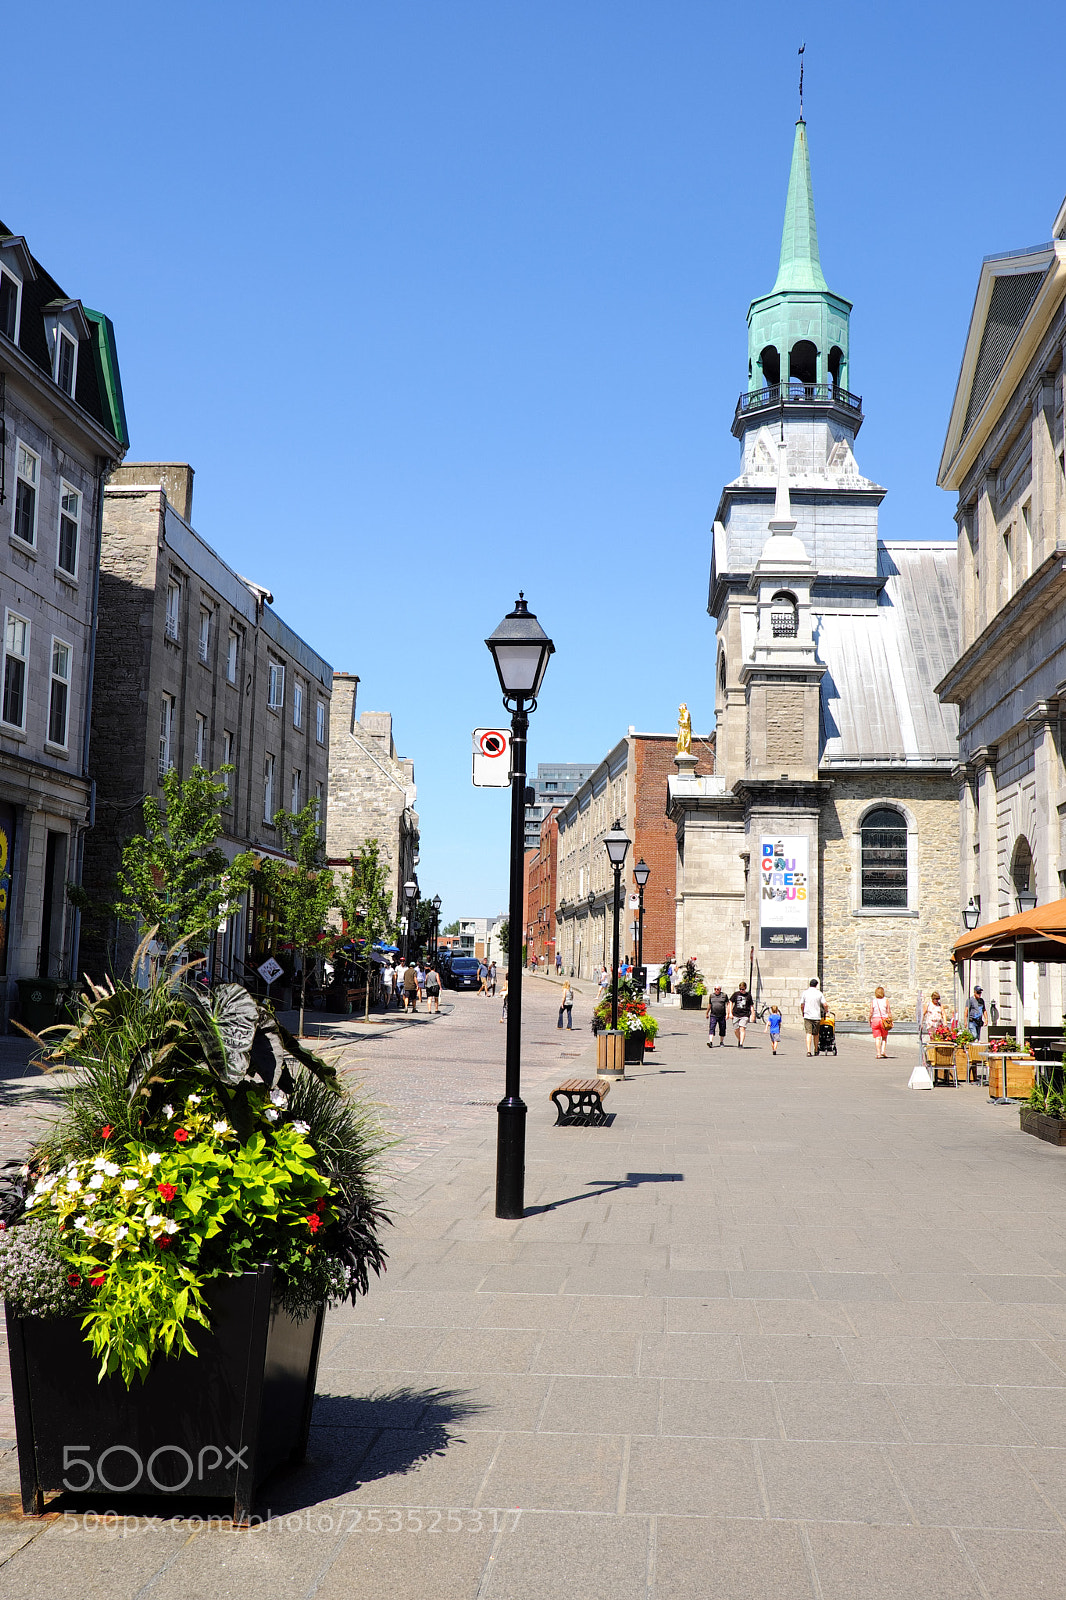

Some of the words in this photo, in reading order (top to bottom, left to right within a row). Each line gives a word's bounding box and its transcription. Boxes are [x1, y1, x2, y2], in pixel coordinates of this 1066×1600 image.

[762, 840, 784, 857] DÉ
[762, 858, 796, 872] COU
[762, 887, 807, 902] NOUS
